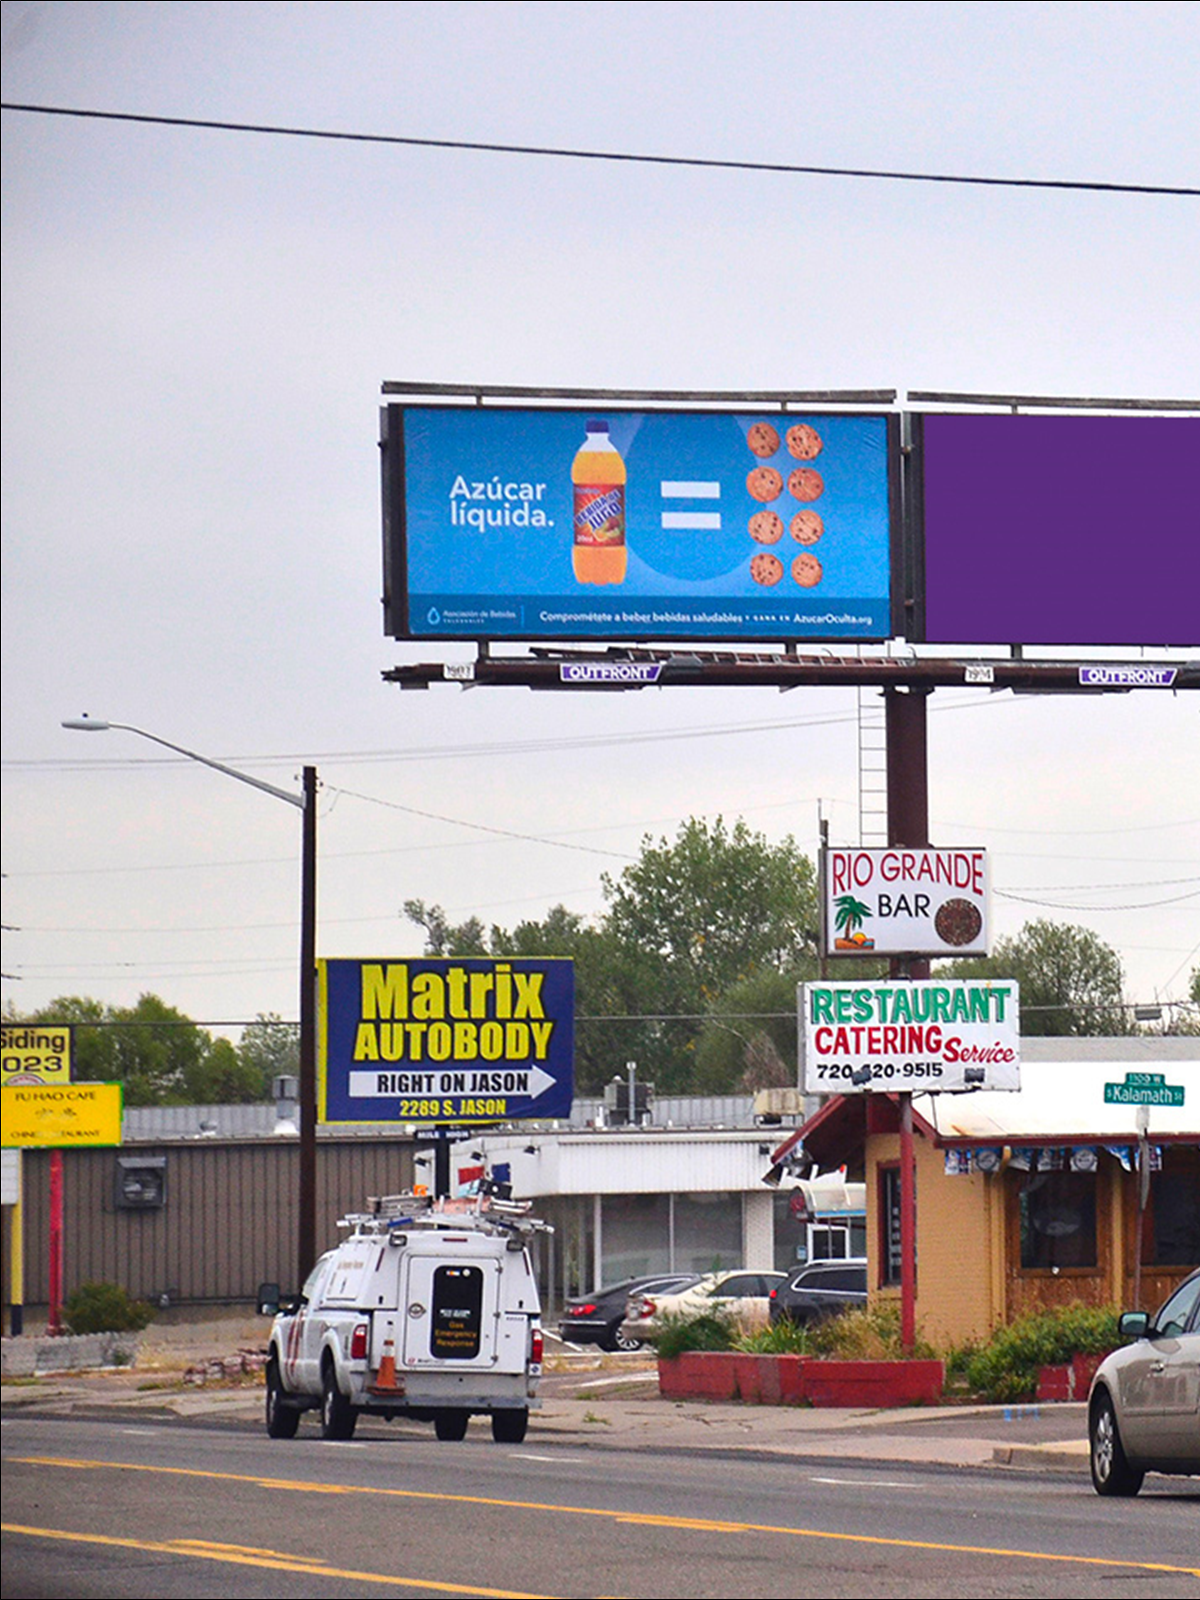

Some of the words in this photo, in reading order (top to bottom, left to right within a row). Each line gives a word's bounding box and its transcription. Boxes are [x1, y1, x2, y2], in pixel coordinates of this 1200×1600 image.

[449, 475, 546, 500] Azúcar
[451, 500, 554, 533] líquida.
[588, 501, 622, 532] JUGO
[539, 611, 612, 623] Comprométete
[614, 613, 620, 621] a
[622, 611, 650, 622] beber
[652, 611, 690, 622] bebidas
[693, 612, 742, 622] saludables
[793, 612, 872, 625] AzucarOculta.org
[569, 667, 651, 679] OUTFRONT
[1088, 670, 1166, 683] OUTFRONT
[833, 853, 873, 896] RIO
[880, 852, 983, 896] GRANDE
[878, 894, 931, 918] BAR
[361, 964, 545, 1020] Matrix
[811, 987, 1011, 1025] RESTAURANT
[1, 1030, 65, 1054] Siding
[353, 1022, 553, 1061] AUTOBODY
[814, 1025, 943, 1056] CATERING
[942, 1036, 1016, 1064] Service
[377, 1073, 435, 1094] RIGHT
[440, 1073, 464, 1093] ON
[469, 1072, 529, 1092] JASON
[1113, 1085, 1173, 1103] Kalamath
[33, 1092, 64, 1101] HAO
[67, 1090, 96, 1100] CAFE
[400, 1099, 439, 1117] 2289
[443, 1099, 456, 1116] S.
[459, 1099, 506, 1116] JASON
[10, 1130, 36, 1139] CHINE
[435, 1329, 477, 1338] Emergency
[437, 1339, 474, 1347] Response
